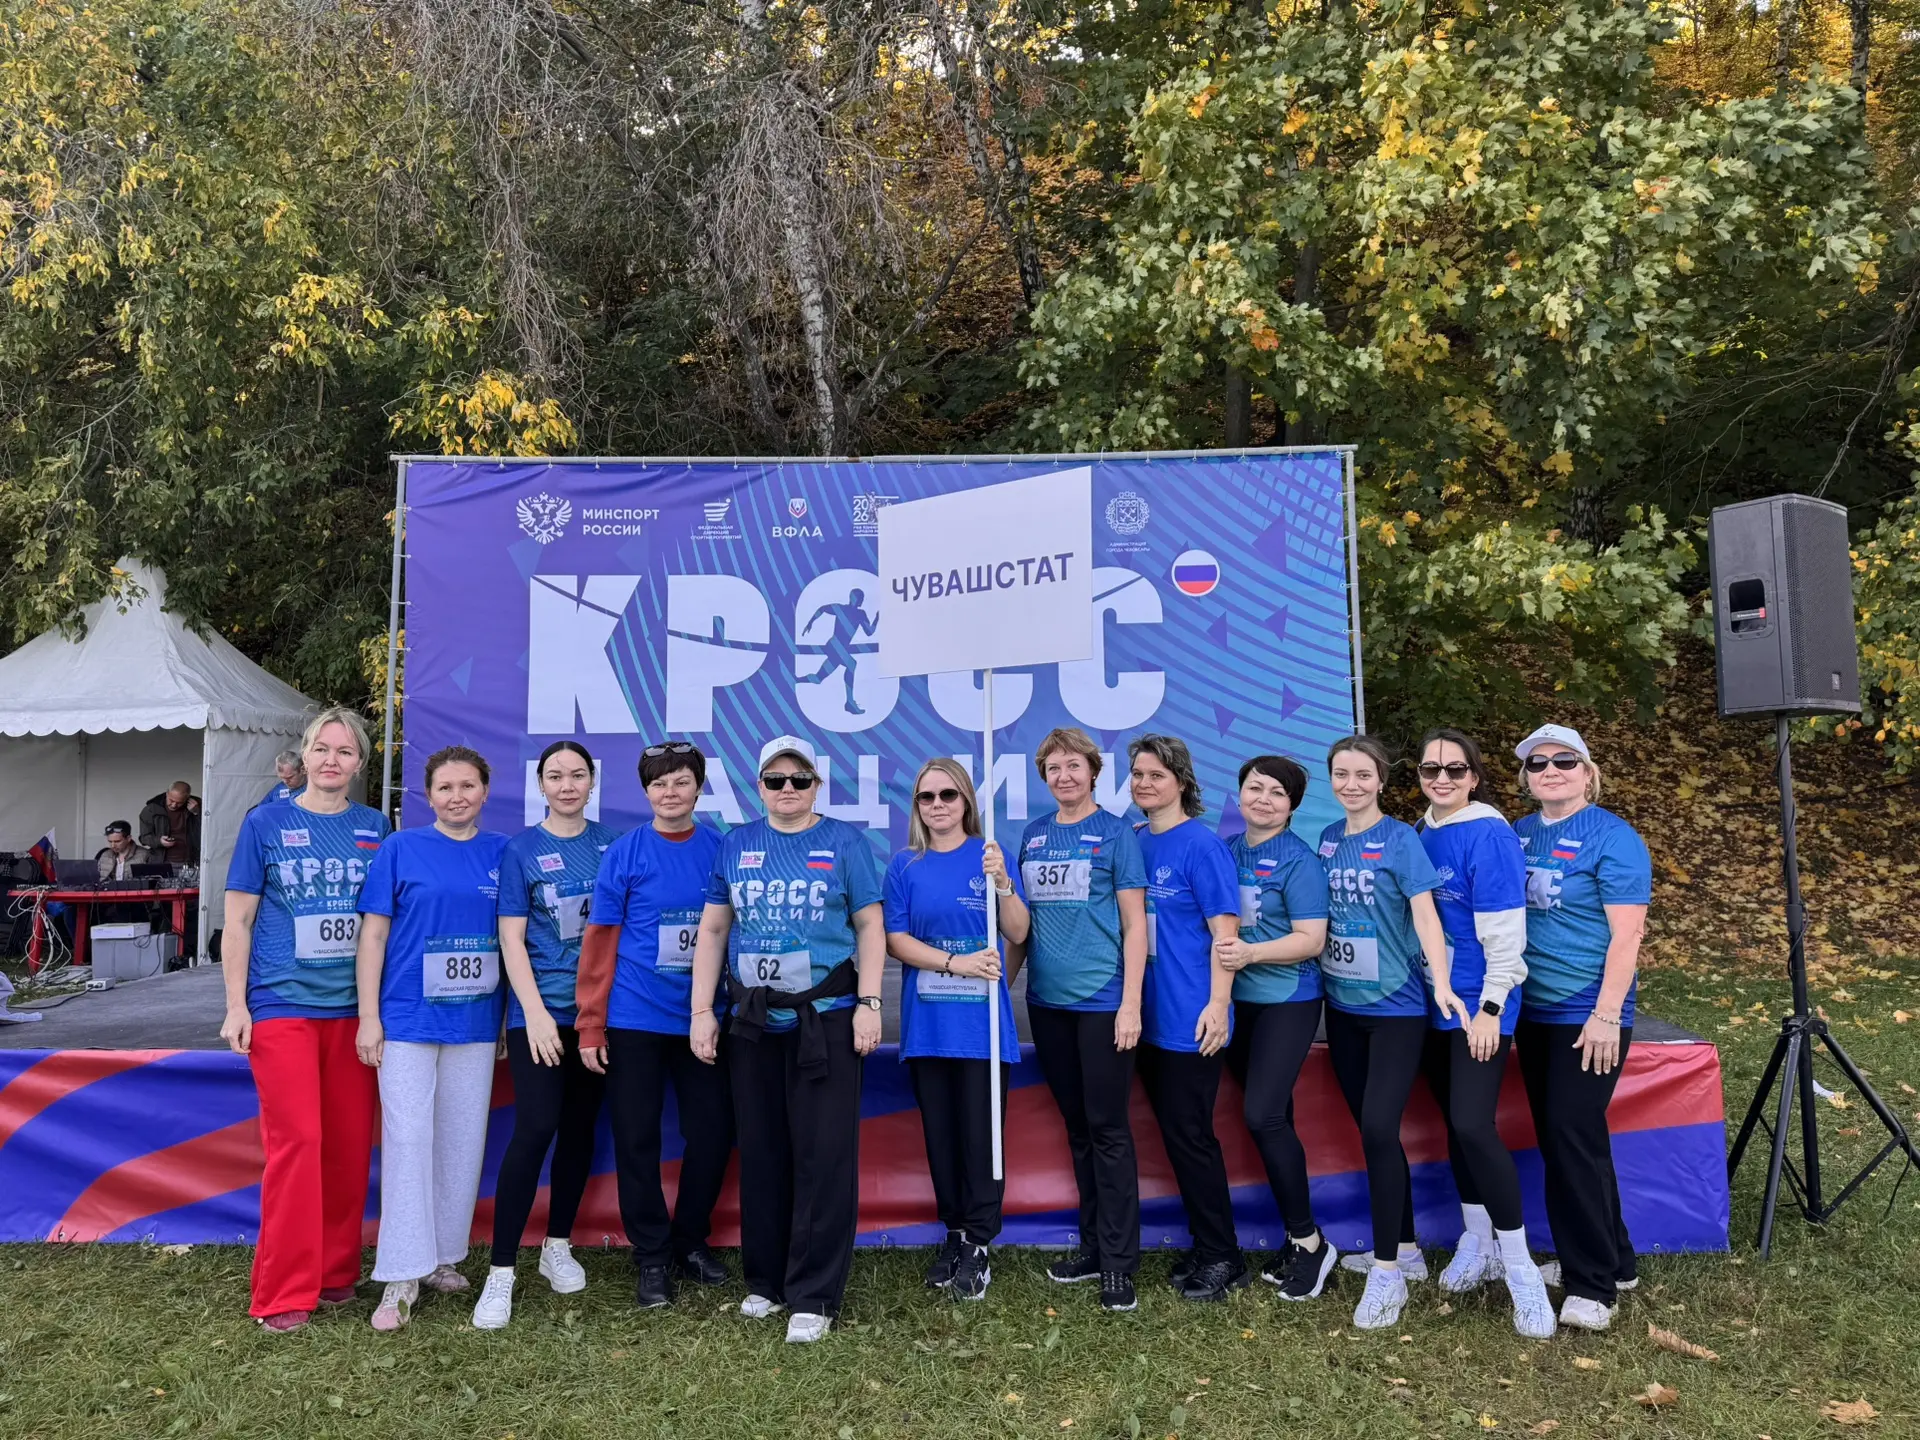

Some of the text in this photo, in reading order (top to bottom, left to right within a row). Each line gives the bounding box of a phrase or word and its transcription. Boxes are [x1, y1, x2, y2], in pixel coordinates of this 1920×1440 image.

[582, 508, 660, 520] МИНСПОРТ
[853, 498, 869, 511] 20
[582, 524, 642, 536] РОССИИ
[772, 525, 824, 539] ВФЛА
[891, 550, 1075, 604] ЧУВАШСТАТ
[278, 857, 374, 887] КРОС
[1037, 862, 1071, 886] 357
[730, 879, 829, 908] КРОСС
[319, 917, 356, 942] 683
[454, 938, 478, 946] КРОСС
[445, 956, 482, 980] 883
[757, 957, 782, 981] 62
